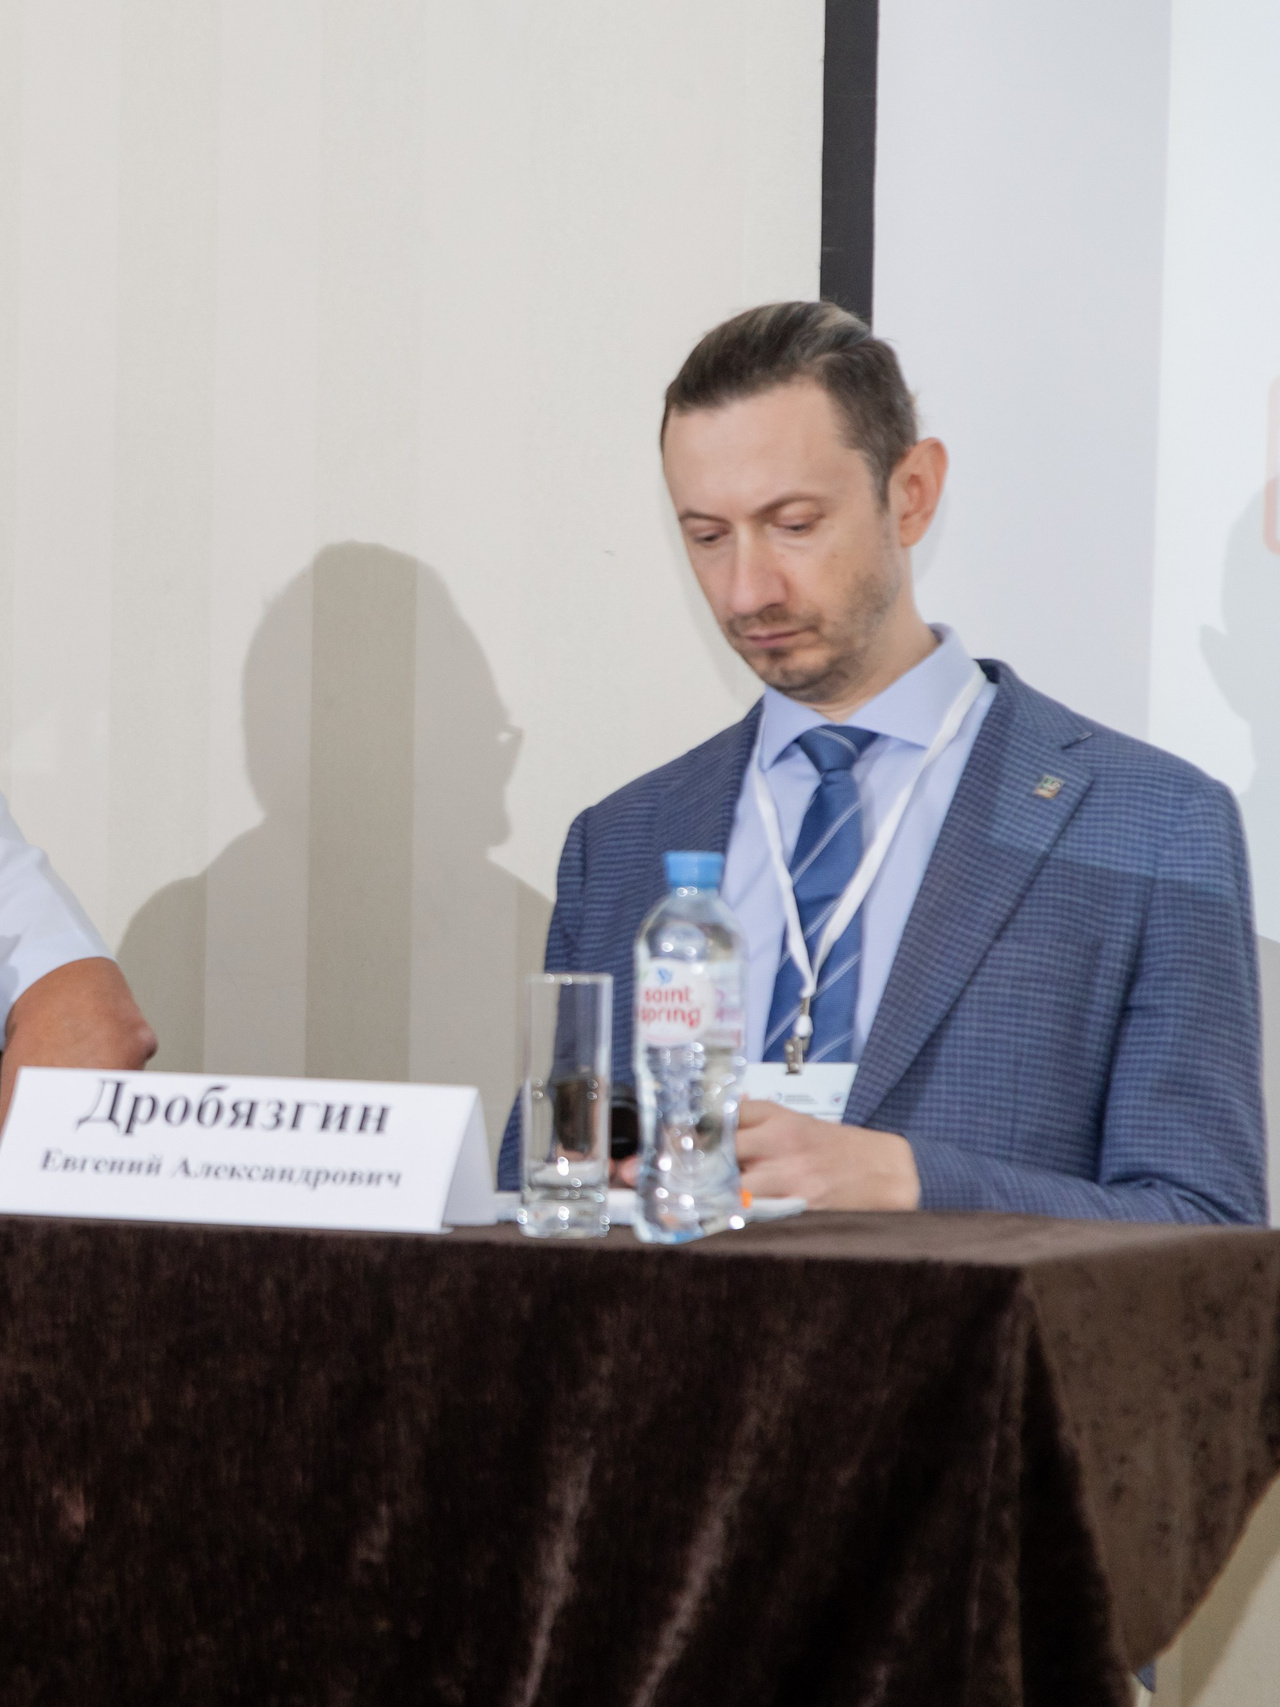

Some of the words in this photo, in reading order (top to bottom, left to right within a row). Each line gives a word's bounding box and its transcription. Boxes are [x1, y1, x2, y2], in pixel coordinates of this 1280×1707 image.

[76, 1078, 393, 1136] Дробязгин
[39, 1147, 162, 1177] Евгений
[169, 1154, 402, 1190] Александрович
